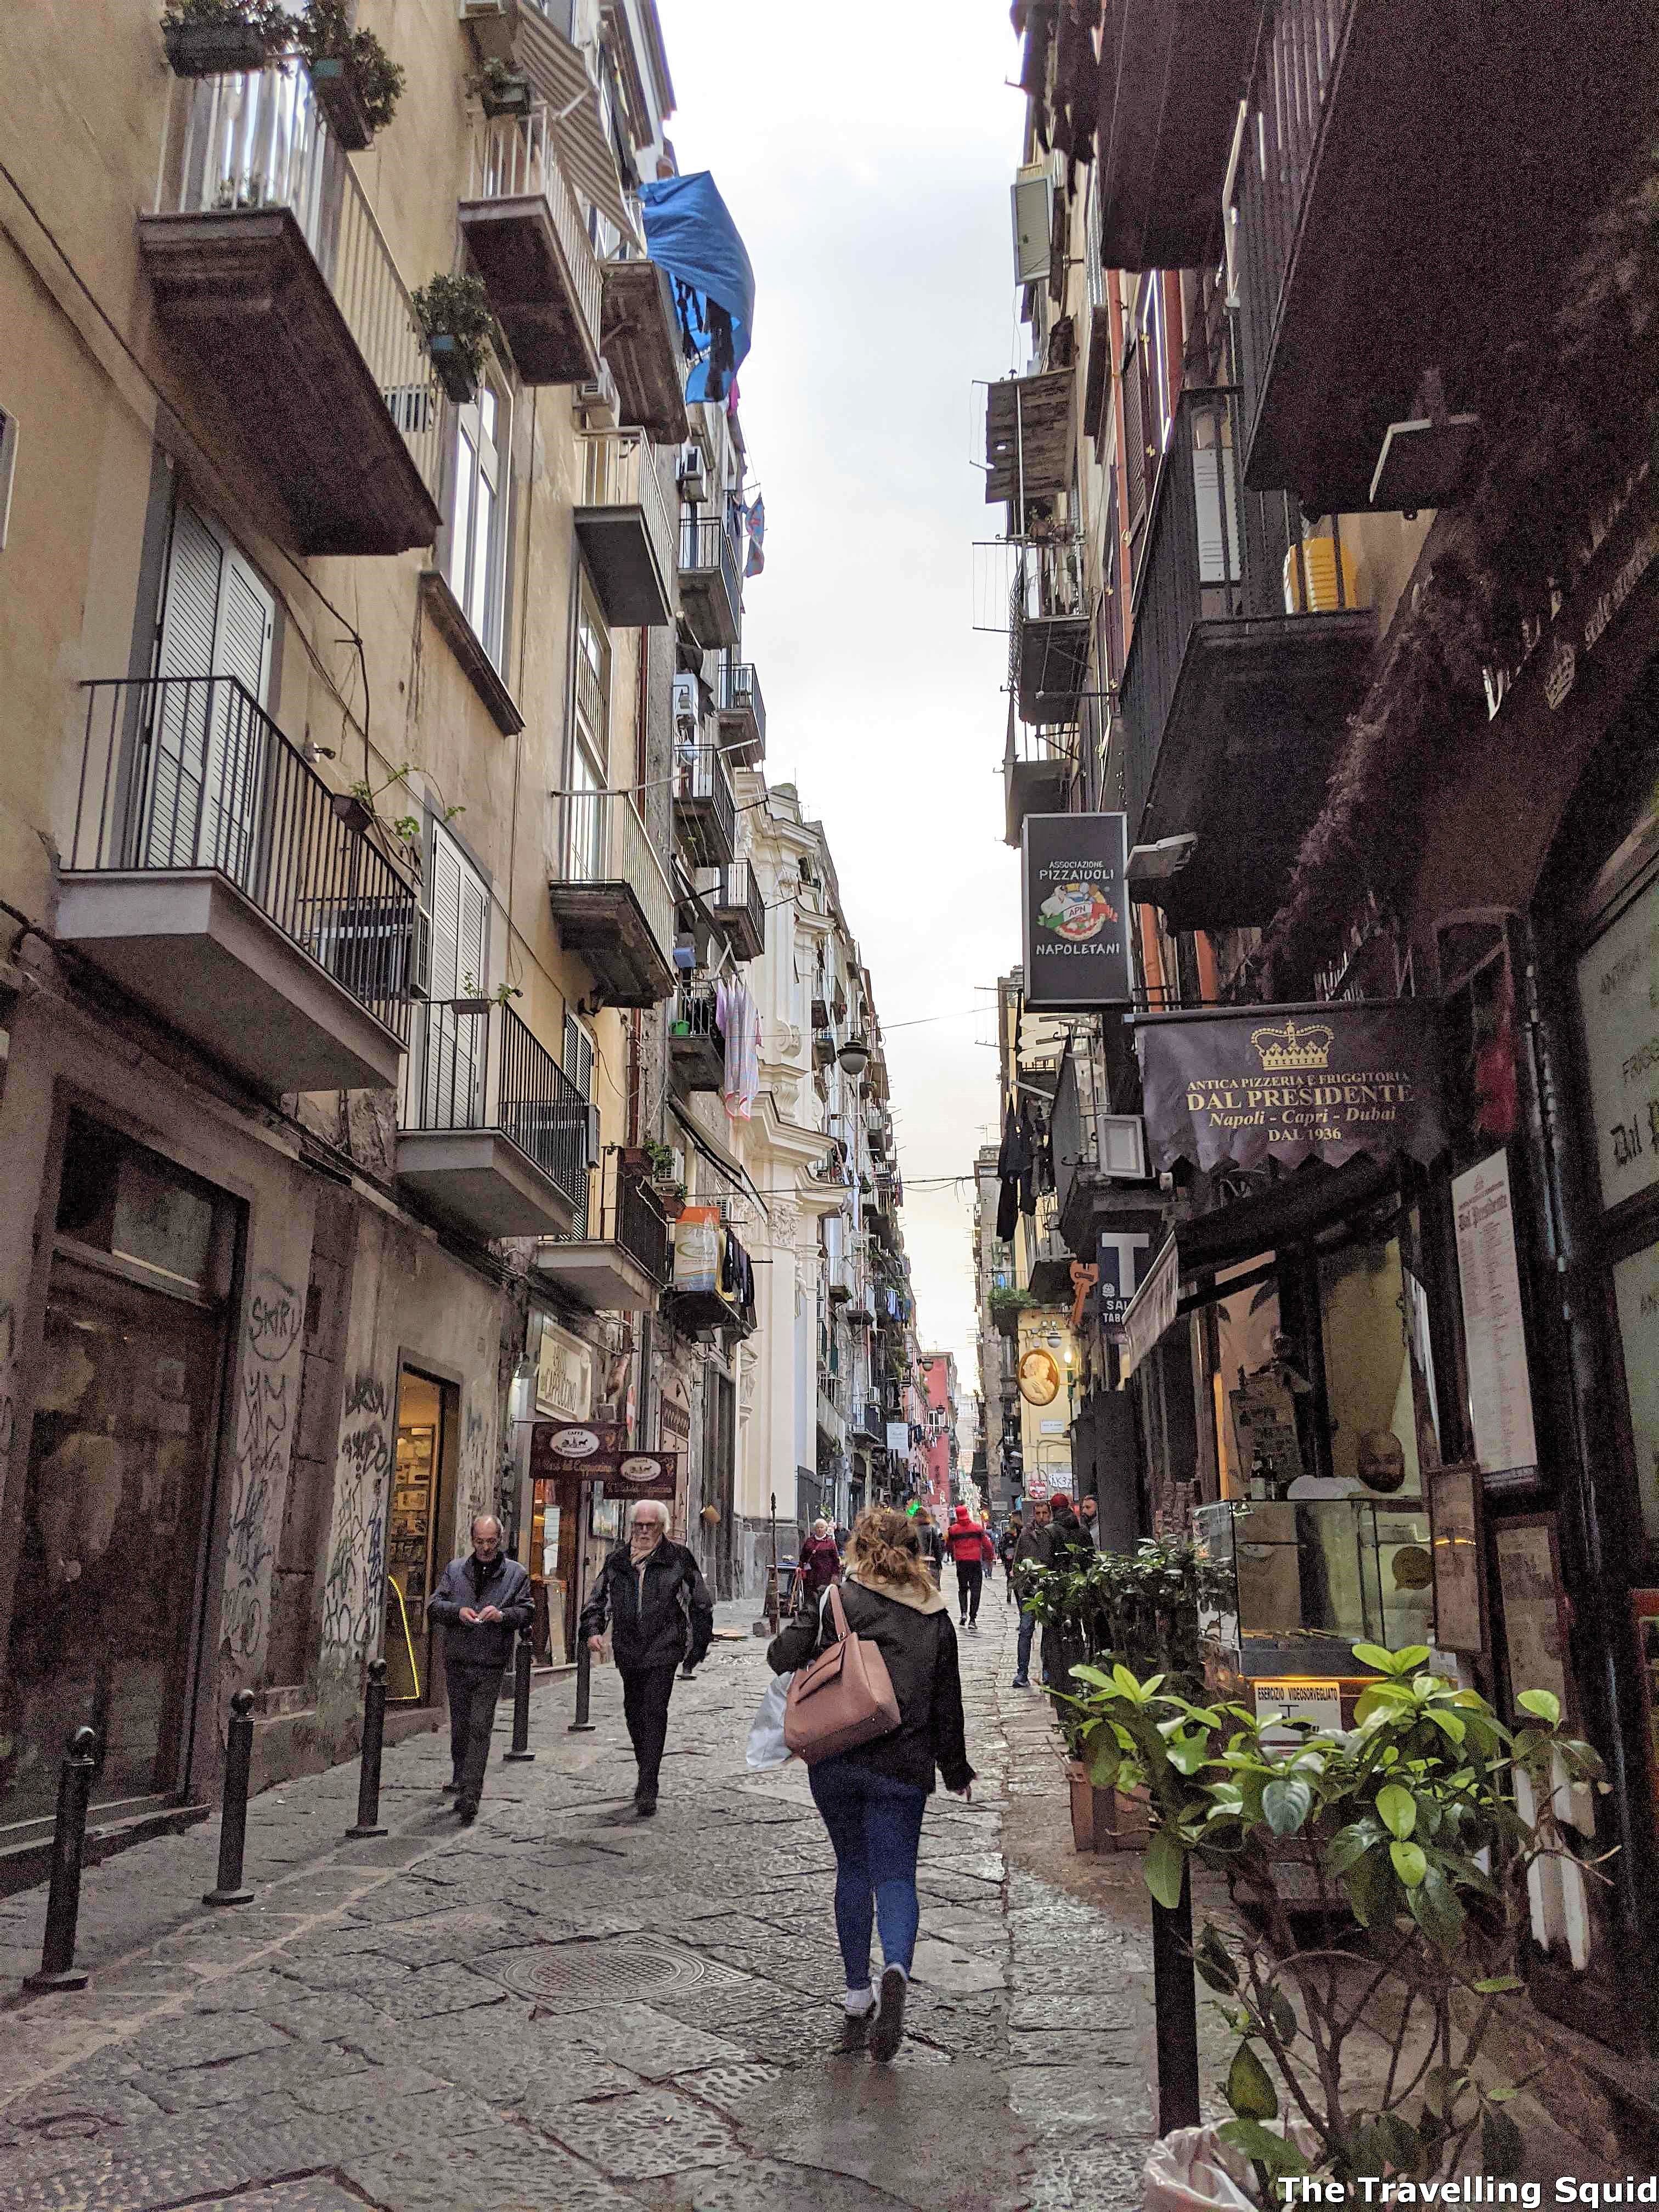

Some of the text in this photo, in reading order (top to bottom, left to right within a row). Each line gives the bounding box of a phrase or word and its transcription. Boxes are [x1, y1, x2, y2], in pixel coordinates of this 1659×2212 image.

[1049, 860, 1104, 868] ASSOCIAZIONE
[1039, 869, 1114, 881] PIZZAIUOLI
[1069, 905, 1086, 917] APN
[1036, 943, 1120, 955] NAPOLETANI
[1187, 1079, 1239, 1091] ANTICA
[1242, 1076, 1304, 1088] PIZZERIA
[1319, 1072, 1409, 1086] FRIGGITORIA
[1186, 1084, 1414, 1111] DAL PRESIDENTE
[1209, 1110, 1266, 1128] Napoli
[1282, 1108, 1328, 1127] Capri
[1346, 1106, 1396, 1122] Dubai
[1268, 1127, 1342, 1142] DAL 1936
[1102, 1232, 1149, 1298] T
[1102, 1313, 1121, 1323] TAB
